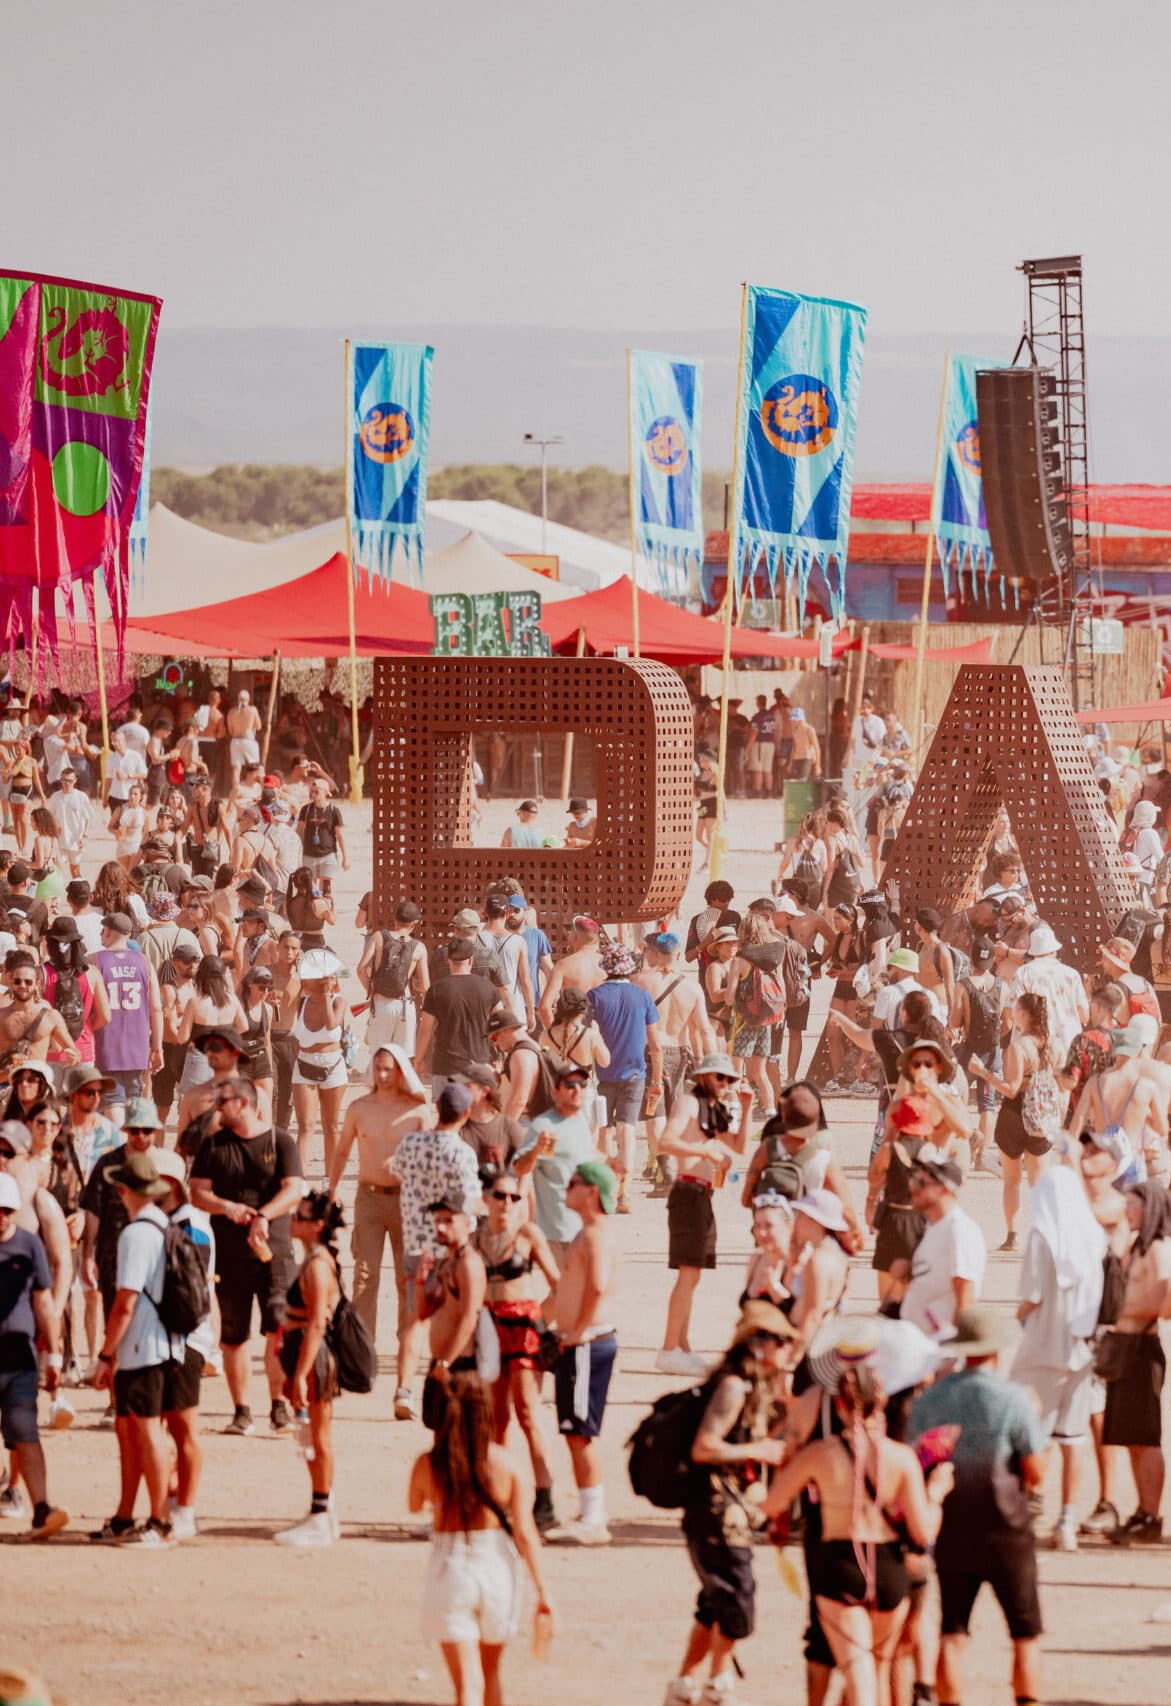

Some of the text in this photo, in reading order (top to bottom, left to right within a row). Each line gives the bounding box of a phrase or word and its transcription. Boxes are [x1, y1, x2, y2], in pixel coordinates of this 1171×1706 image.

[429, 591, 552, 657] BAR
[111, 966, 137, 979] NASH
[107, 982, 142, 1010] 13
